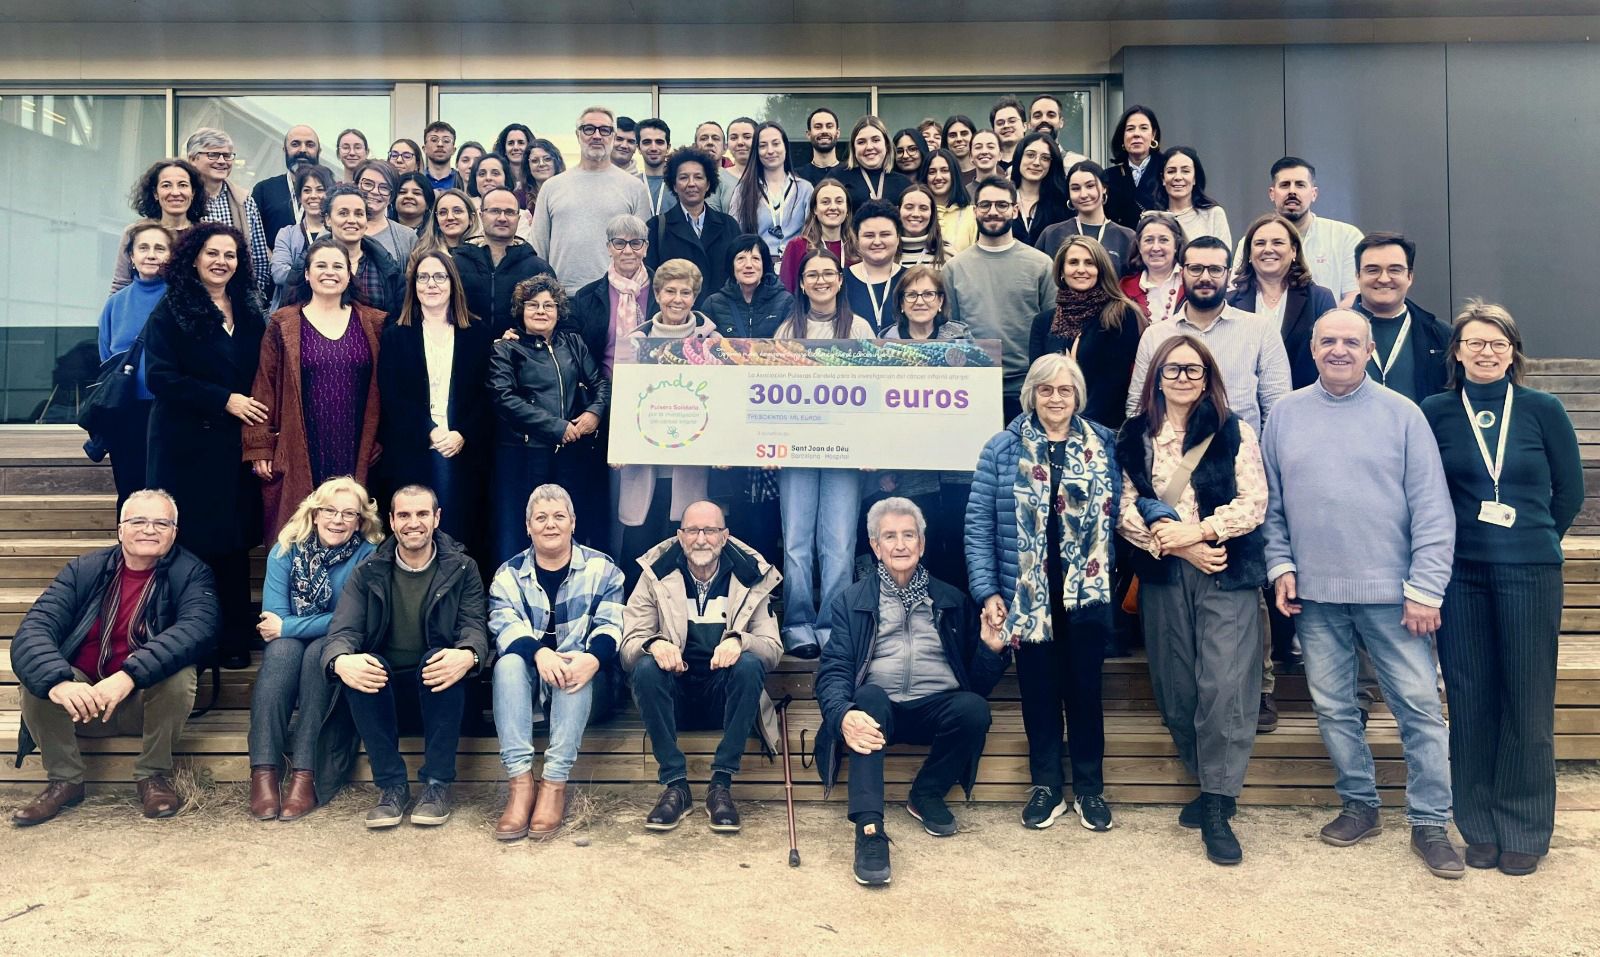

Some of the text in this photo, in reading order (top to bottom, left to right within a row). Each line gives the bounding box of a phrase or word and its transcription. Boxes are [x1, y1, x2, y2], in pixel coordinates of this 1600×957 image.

[749, 383, 969, 409] 300.000 euros
[756, 444, 788, 459] SJD
[791, 444, 807, 452] Sant
